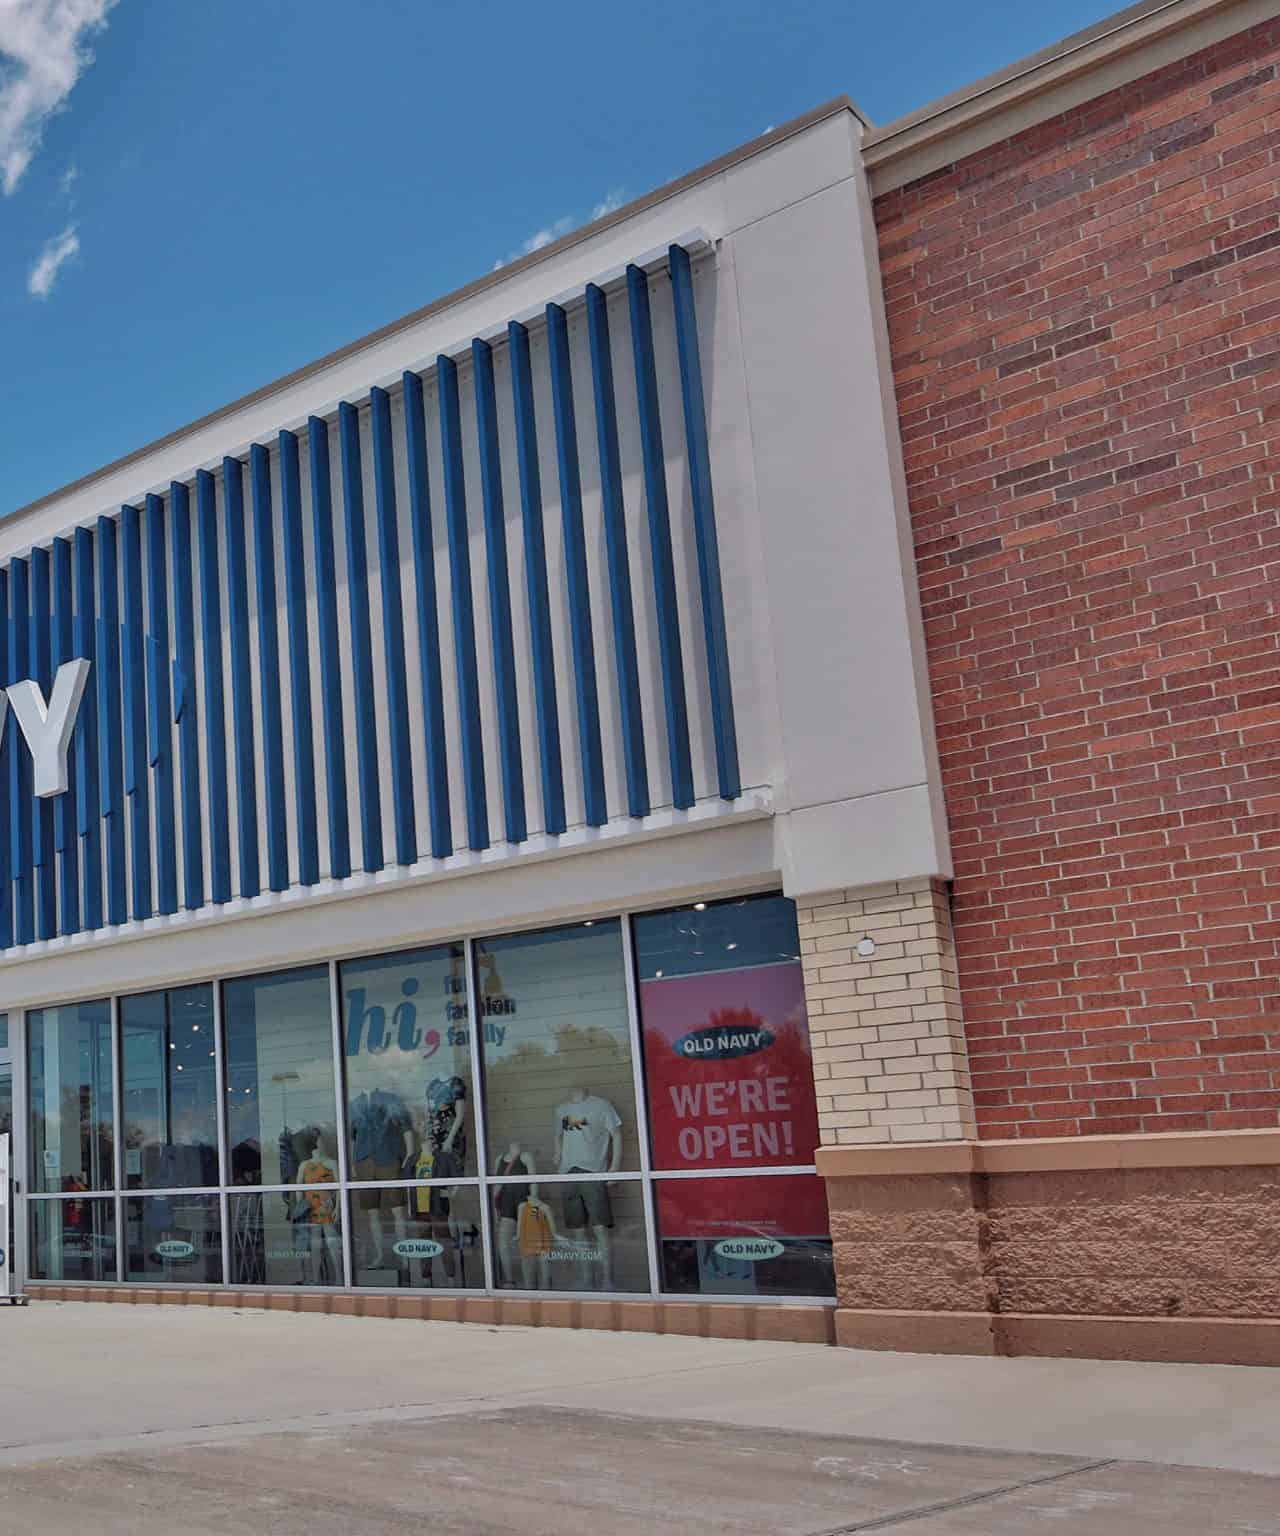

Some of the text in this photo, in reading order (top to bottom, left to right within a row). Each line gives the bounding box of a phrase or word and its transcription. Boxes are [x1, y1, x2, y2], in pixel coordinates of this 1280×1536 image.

[345, 977, 441, 1060] hi,
[683, 1032, 762, 1054] OLD NAVY
[670, 1076, 791, 1119] WE'RE
[678, 1120, 794, 1161] OPEN!
[398, 1244, 438, 1253] OLD NAVY
[722, 1244, 776, 1255] OLD NAVY
